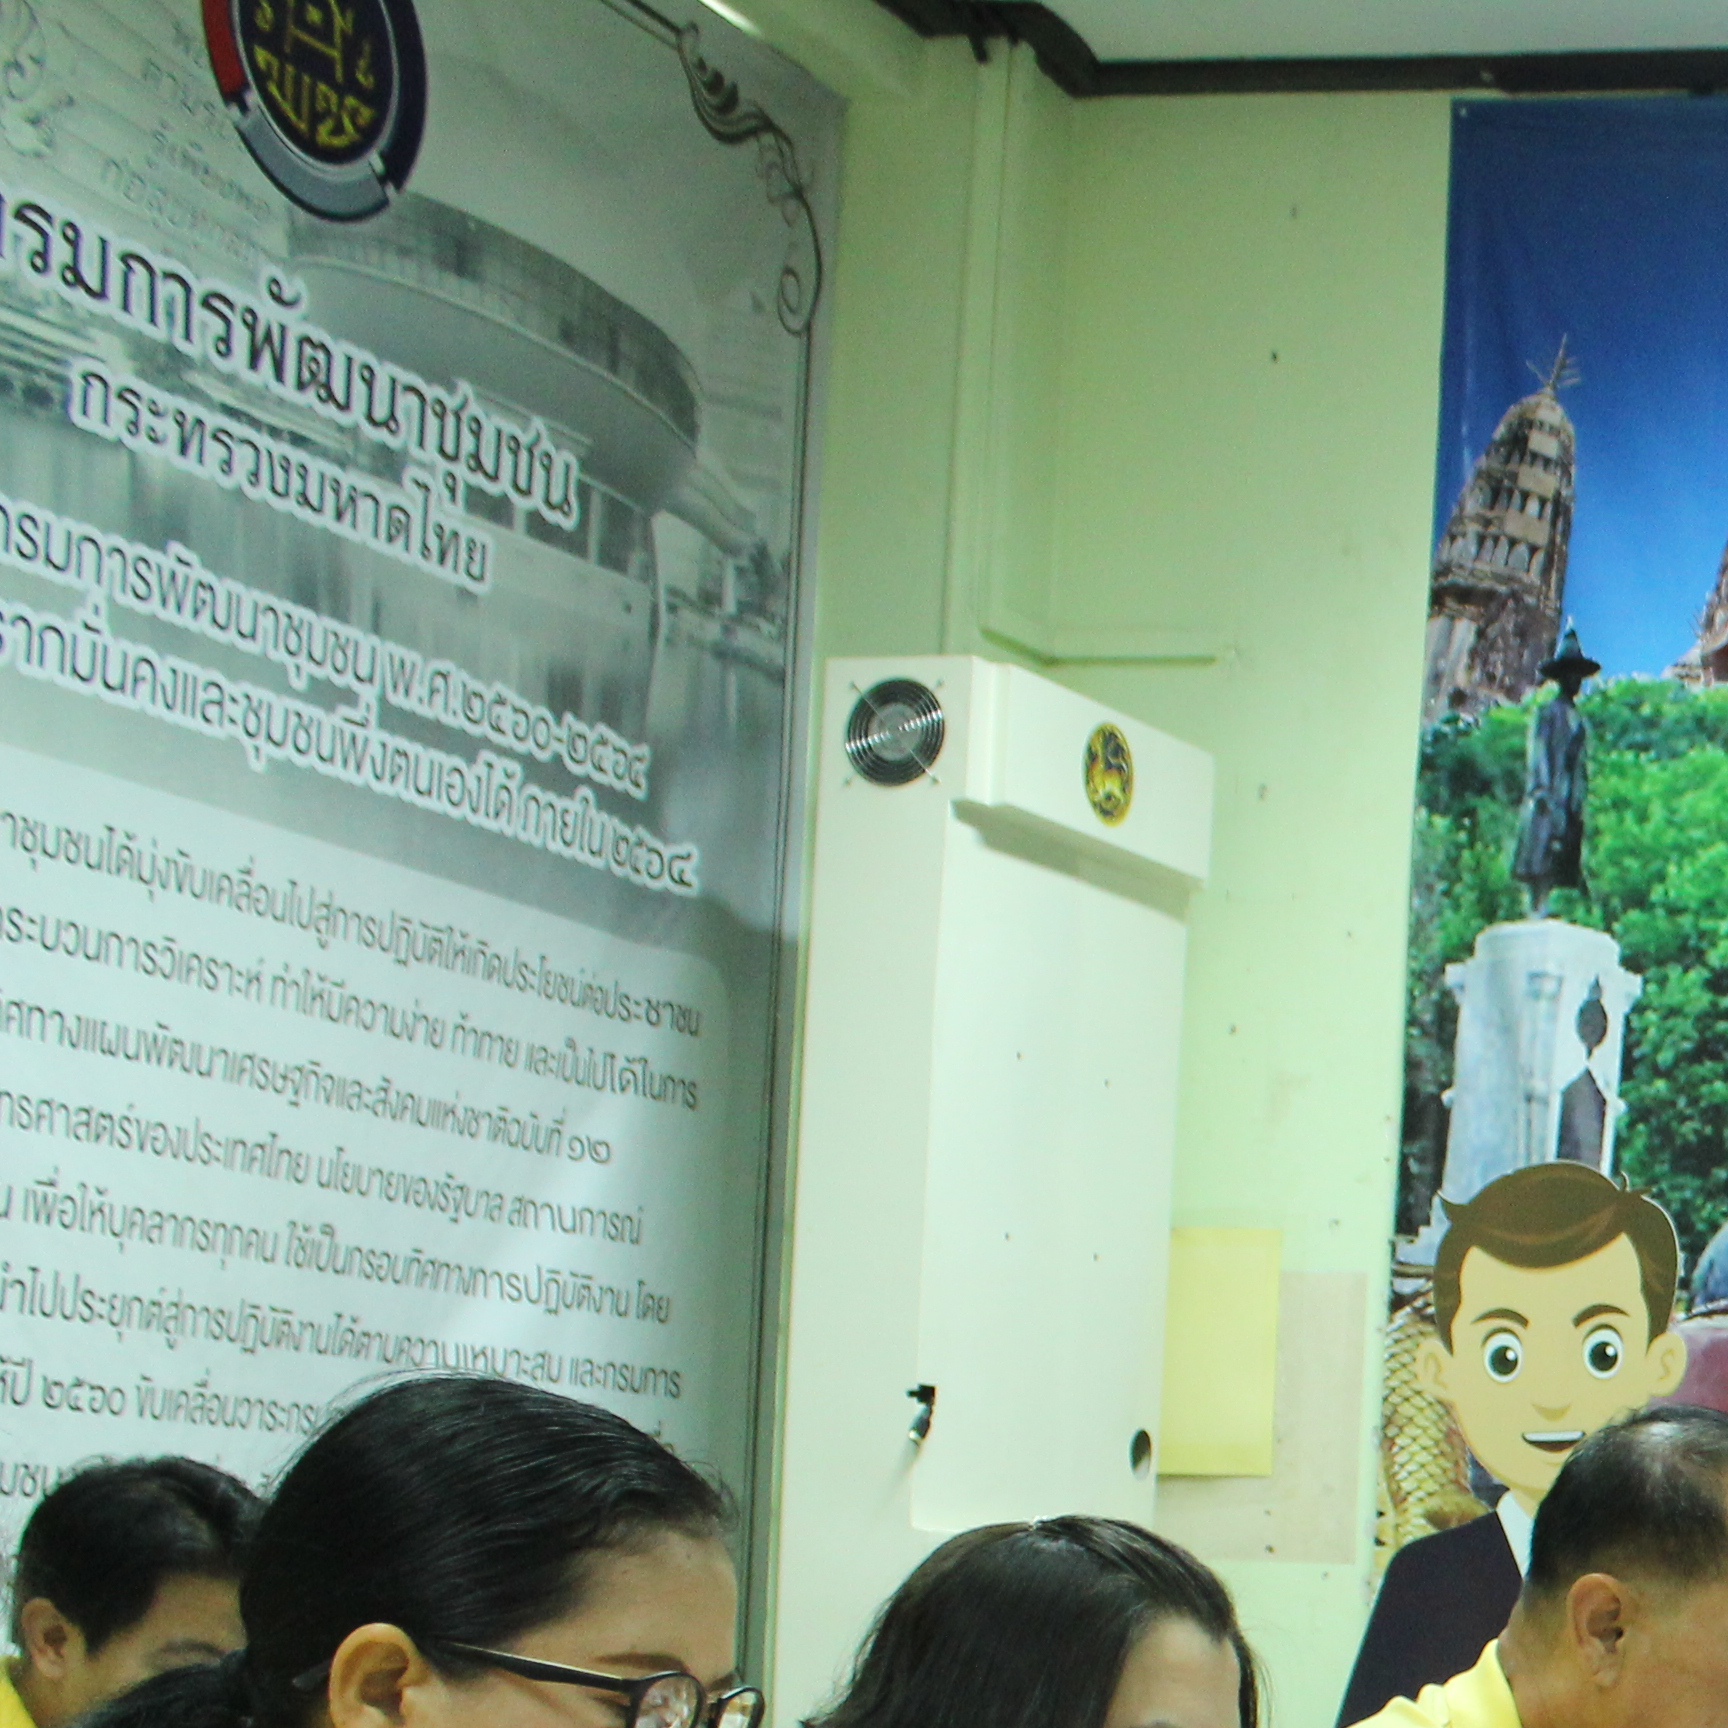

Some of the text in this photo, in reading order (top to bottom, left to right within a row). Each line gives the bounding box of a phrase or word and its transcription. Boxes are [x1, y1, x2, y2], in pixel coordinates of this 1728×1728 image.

[0, 194, 577, 518] รมการพัฒนาชุมชน
[81, 371, 487, 584] กระทรวงมหาดไทย
[0, 603, 514, 834] ากมั่นคงและชุมชนพึ่งตนเองได้
[0, 906, 262, 1003] ระบวนการวิเคราะห์
